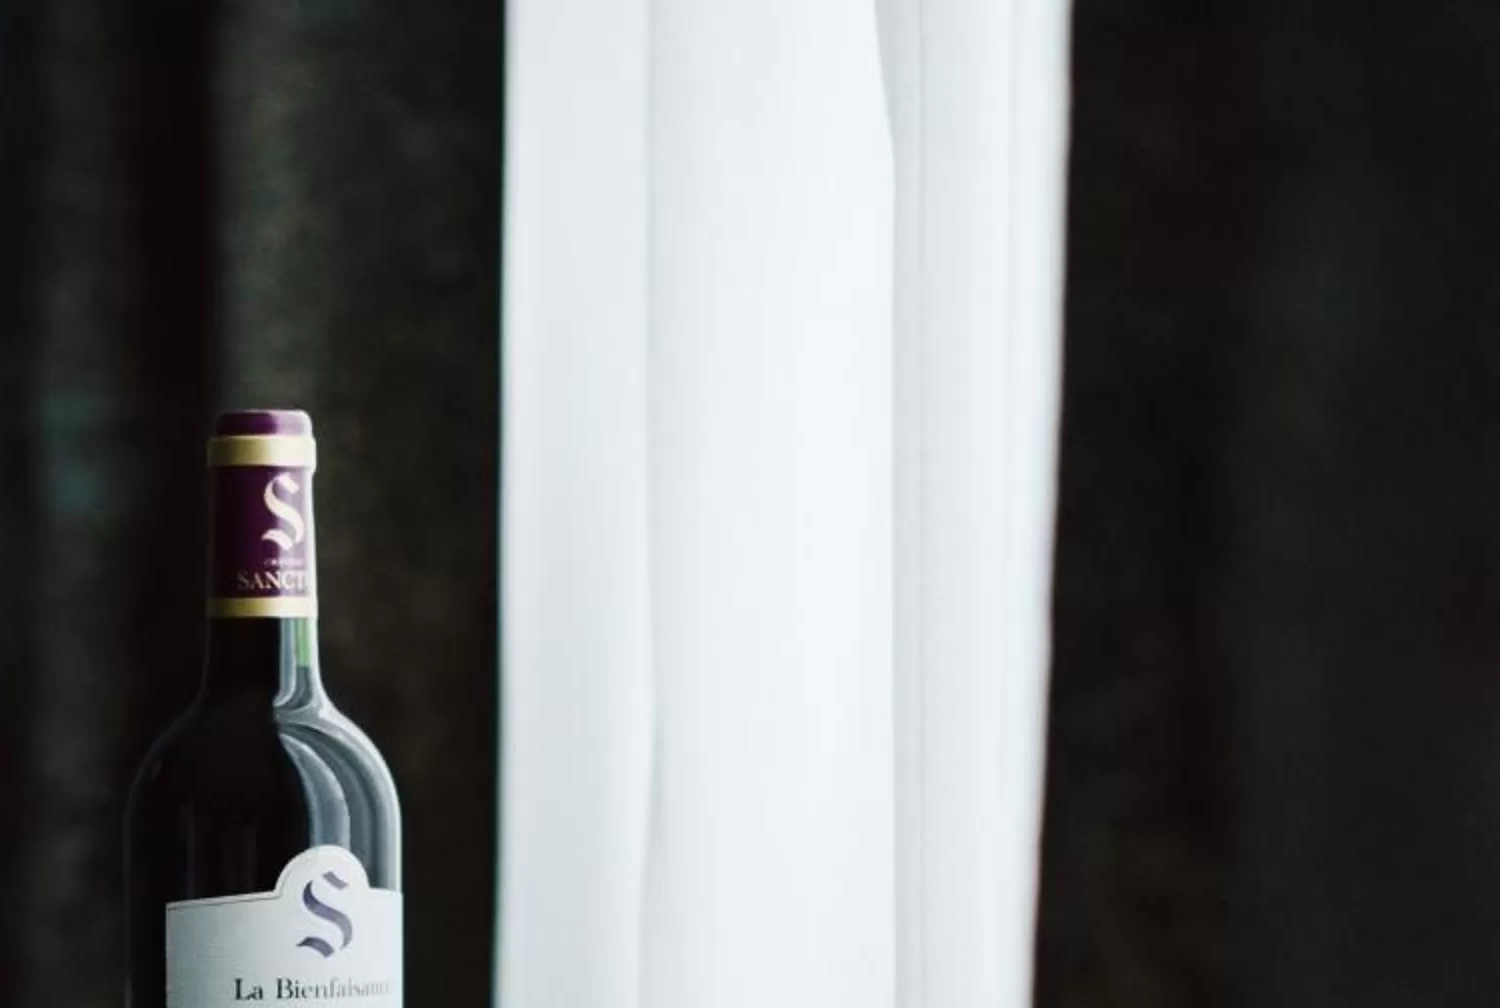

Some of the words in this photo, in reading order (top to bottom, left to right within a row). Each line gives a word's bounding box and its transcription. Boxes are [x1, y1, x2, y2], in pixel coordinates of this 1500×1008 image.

[236, 570, 312, 590] SANCT
[296, 871, 353, 959] S
[234, 977, 264, 1001] La
